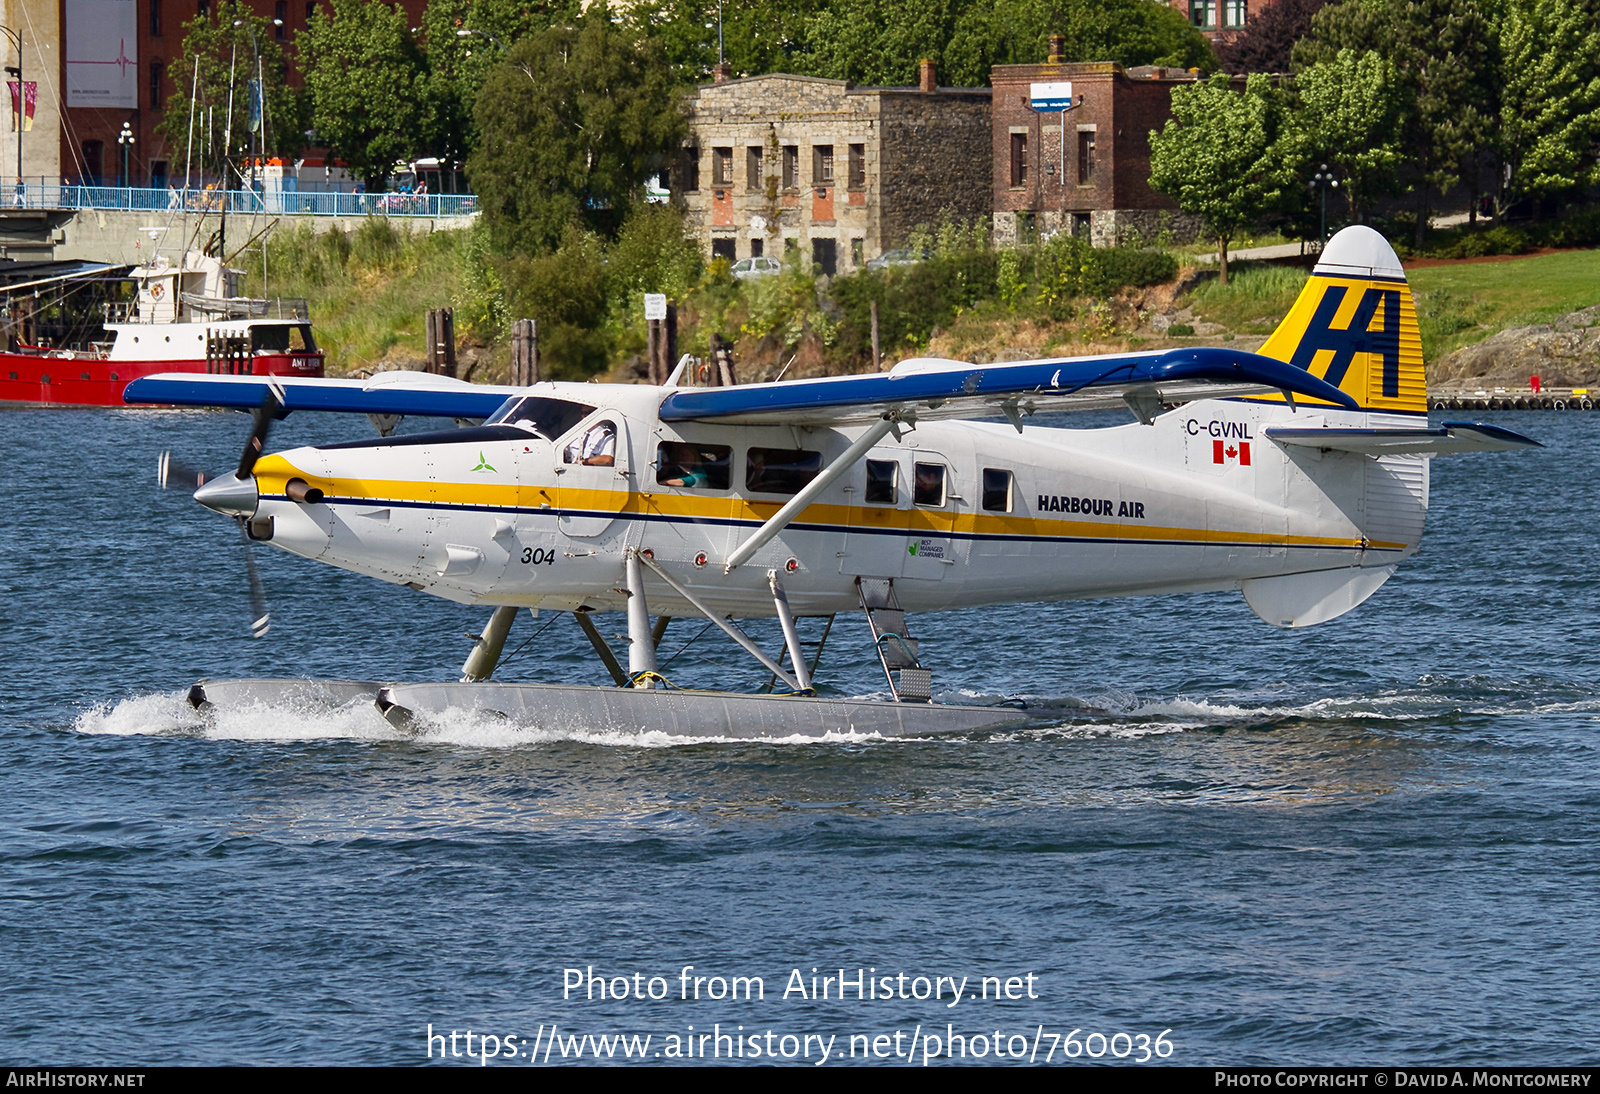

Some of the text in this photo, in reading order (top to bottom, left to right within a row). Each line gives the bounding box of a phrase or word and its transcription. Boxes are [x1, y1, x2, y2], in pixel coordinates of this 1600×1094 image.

[1187, 419, 1253, 439] C-GVNL
[1038, 495, 1145, 518] HARBOUR AIR
[521, 547, 555, 565] 304
